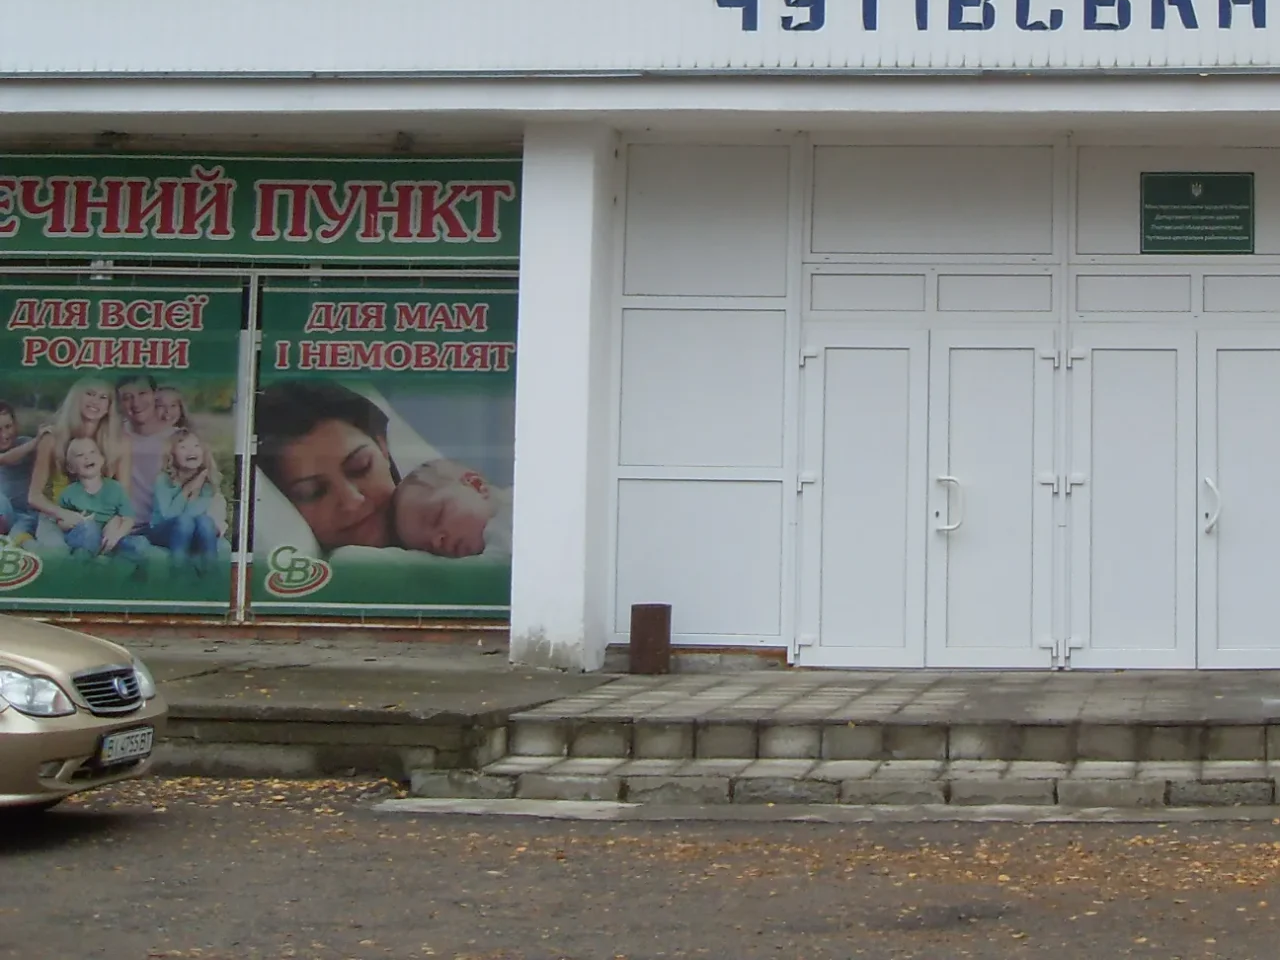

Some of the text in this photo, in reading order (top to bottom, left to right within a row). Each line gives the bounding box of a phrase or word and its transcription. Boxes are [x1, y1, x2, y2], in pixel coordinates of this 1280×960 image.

[257, 183, 512, 241] ПУНКТ
[10, 297, 206, 330] ДЛЯ ВСІЄЇ
[306, 303, 486, 331] ДЛЯ МАМ
[24, 339, 188, 368] РОДИНИ
[301, 342, 513, 370] НЕМОВЛЯТ
